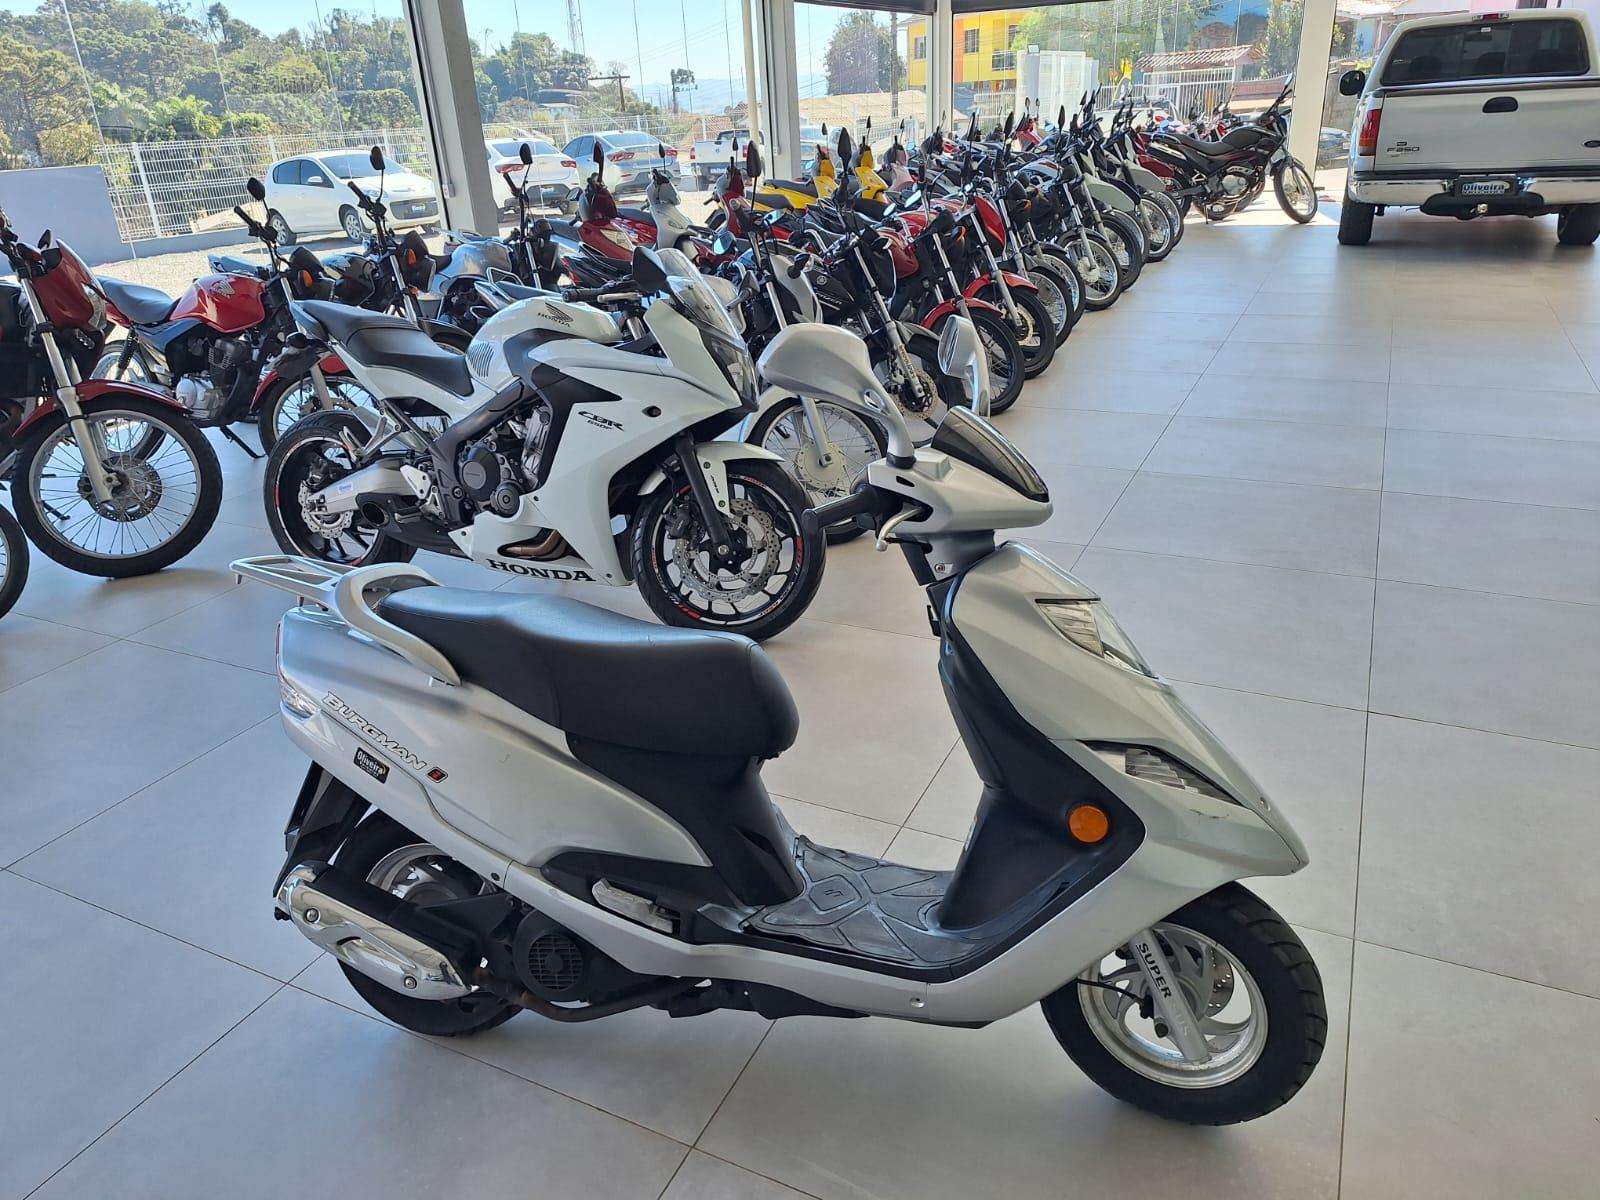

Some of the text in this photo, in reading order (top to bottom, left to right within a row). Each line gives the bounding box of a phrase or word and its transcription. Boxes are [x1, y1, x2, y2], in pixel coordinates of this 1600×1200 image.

[1462, 183, 1505, 191] Oliveira
[578, 411, 625, 431] CBR
[486, 559, 597, 582] HONDA
[321, 690, 427, 770] BURGMAN
[356, 750, 384, 775] Oliveira
[1138, 943, 1172, 998] SUPER
